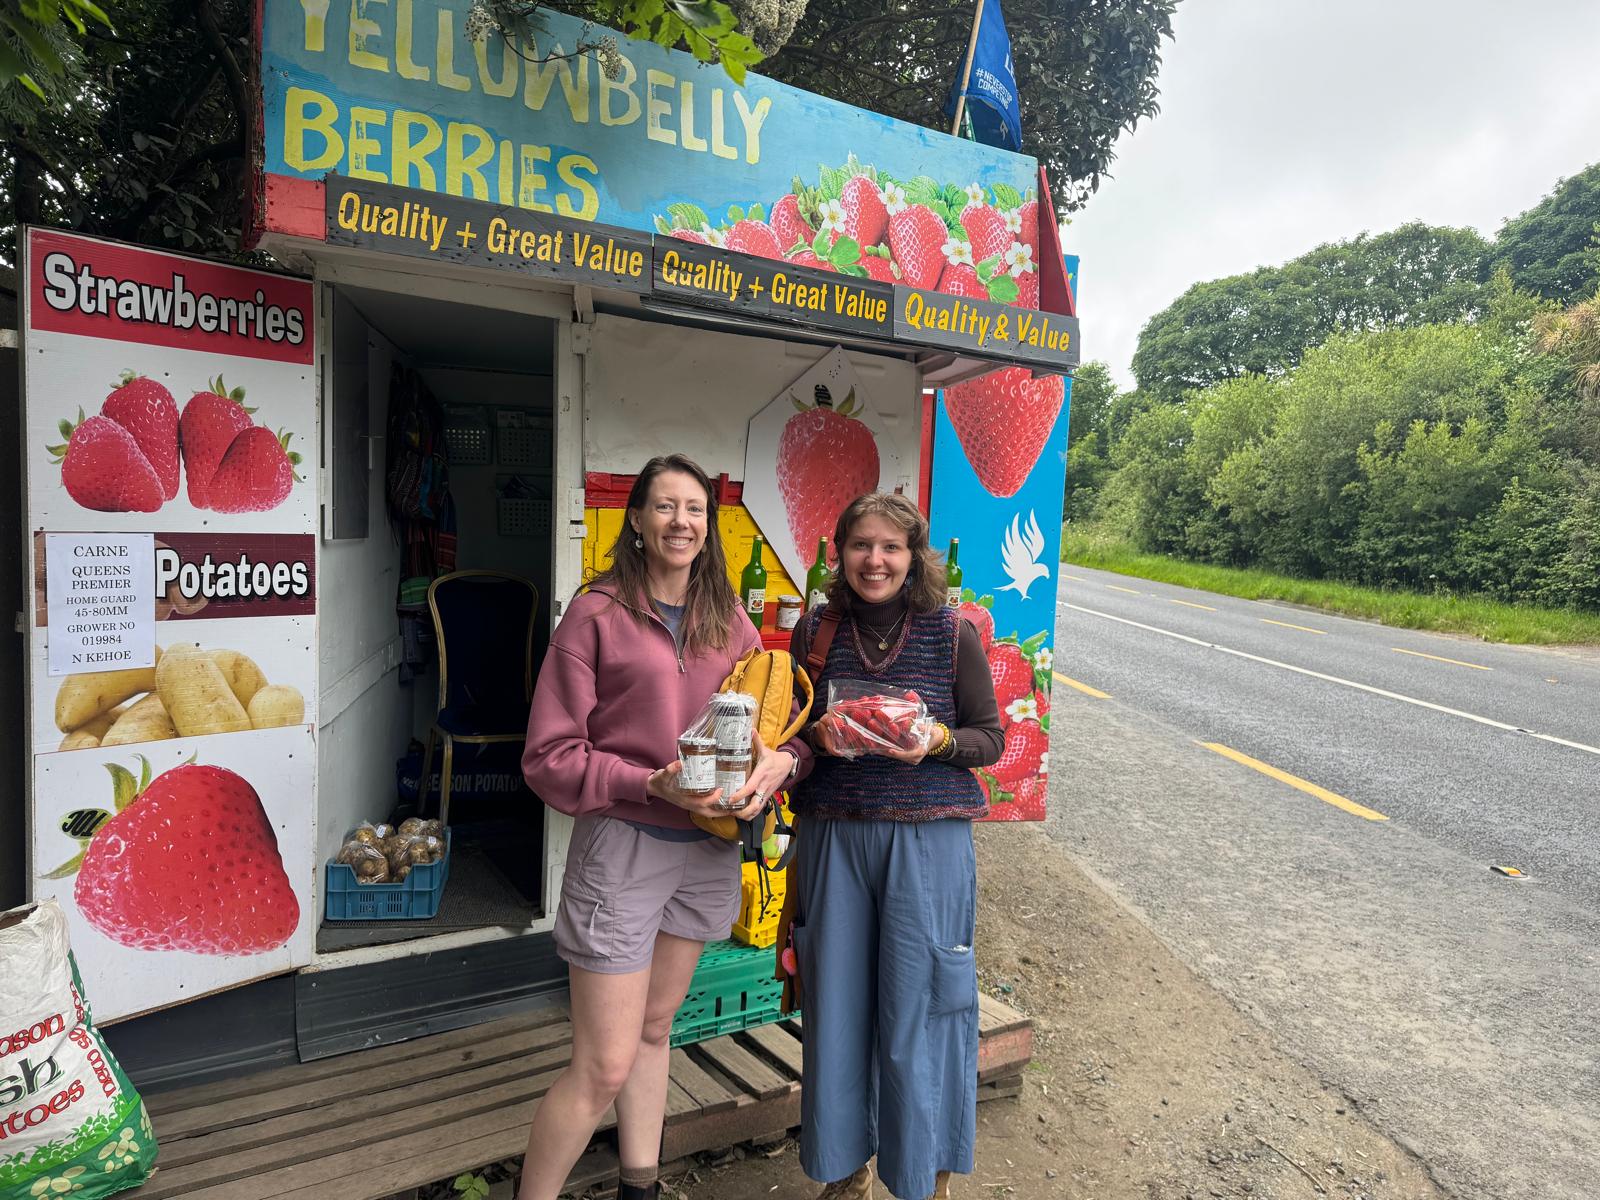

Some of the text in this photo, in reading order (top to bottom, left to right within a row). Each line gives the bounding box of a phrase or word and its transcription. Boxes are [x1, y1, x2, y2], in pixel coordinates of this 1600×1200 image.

[299, 0, 772, 164] YELLOWBELLY
[284, 86, 600, 222] BERRIES
[338, 191, 644, 277] Quality + Great Value
[662, 250, 887, 323] Quality + Great Value
[43, 252, 305, 346] Strawberries
[905, 292, 1070, 352] Quality & Value
[73, 545, 129, 557] CARNE
[72, 565, 131, 578] QUEENS
[155, 548, 309, 599] Potatoes
[72, 579, 131, 590] PREMIER
[66, 595, 137, 605] HOME GUARD
[74, 606, 128, 617] 45-80MM
[67, 621, 135, 633] GROWER NO
[81, 634, 122, 646] 019984
[72, 650, 132, 664] N KEHOE
